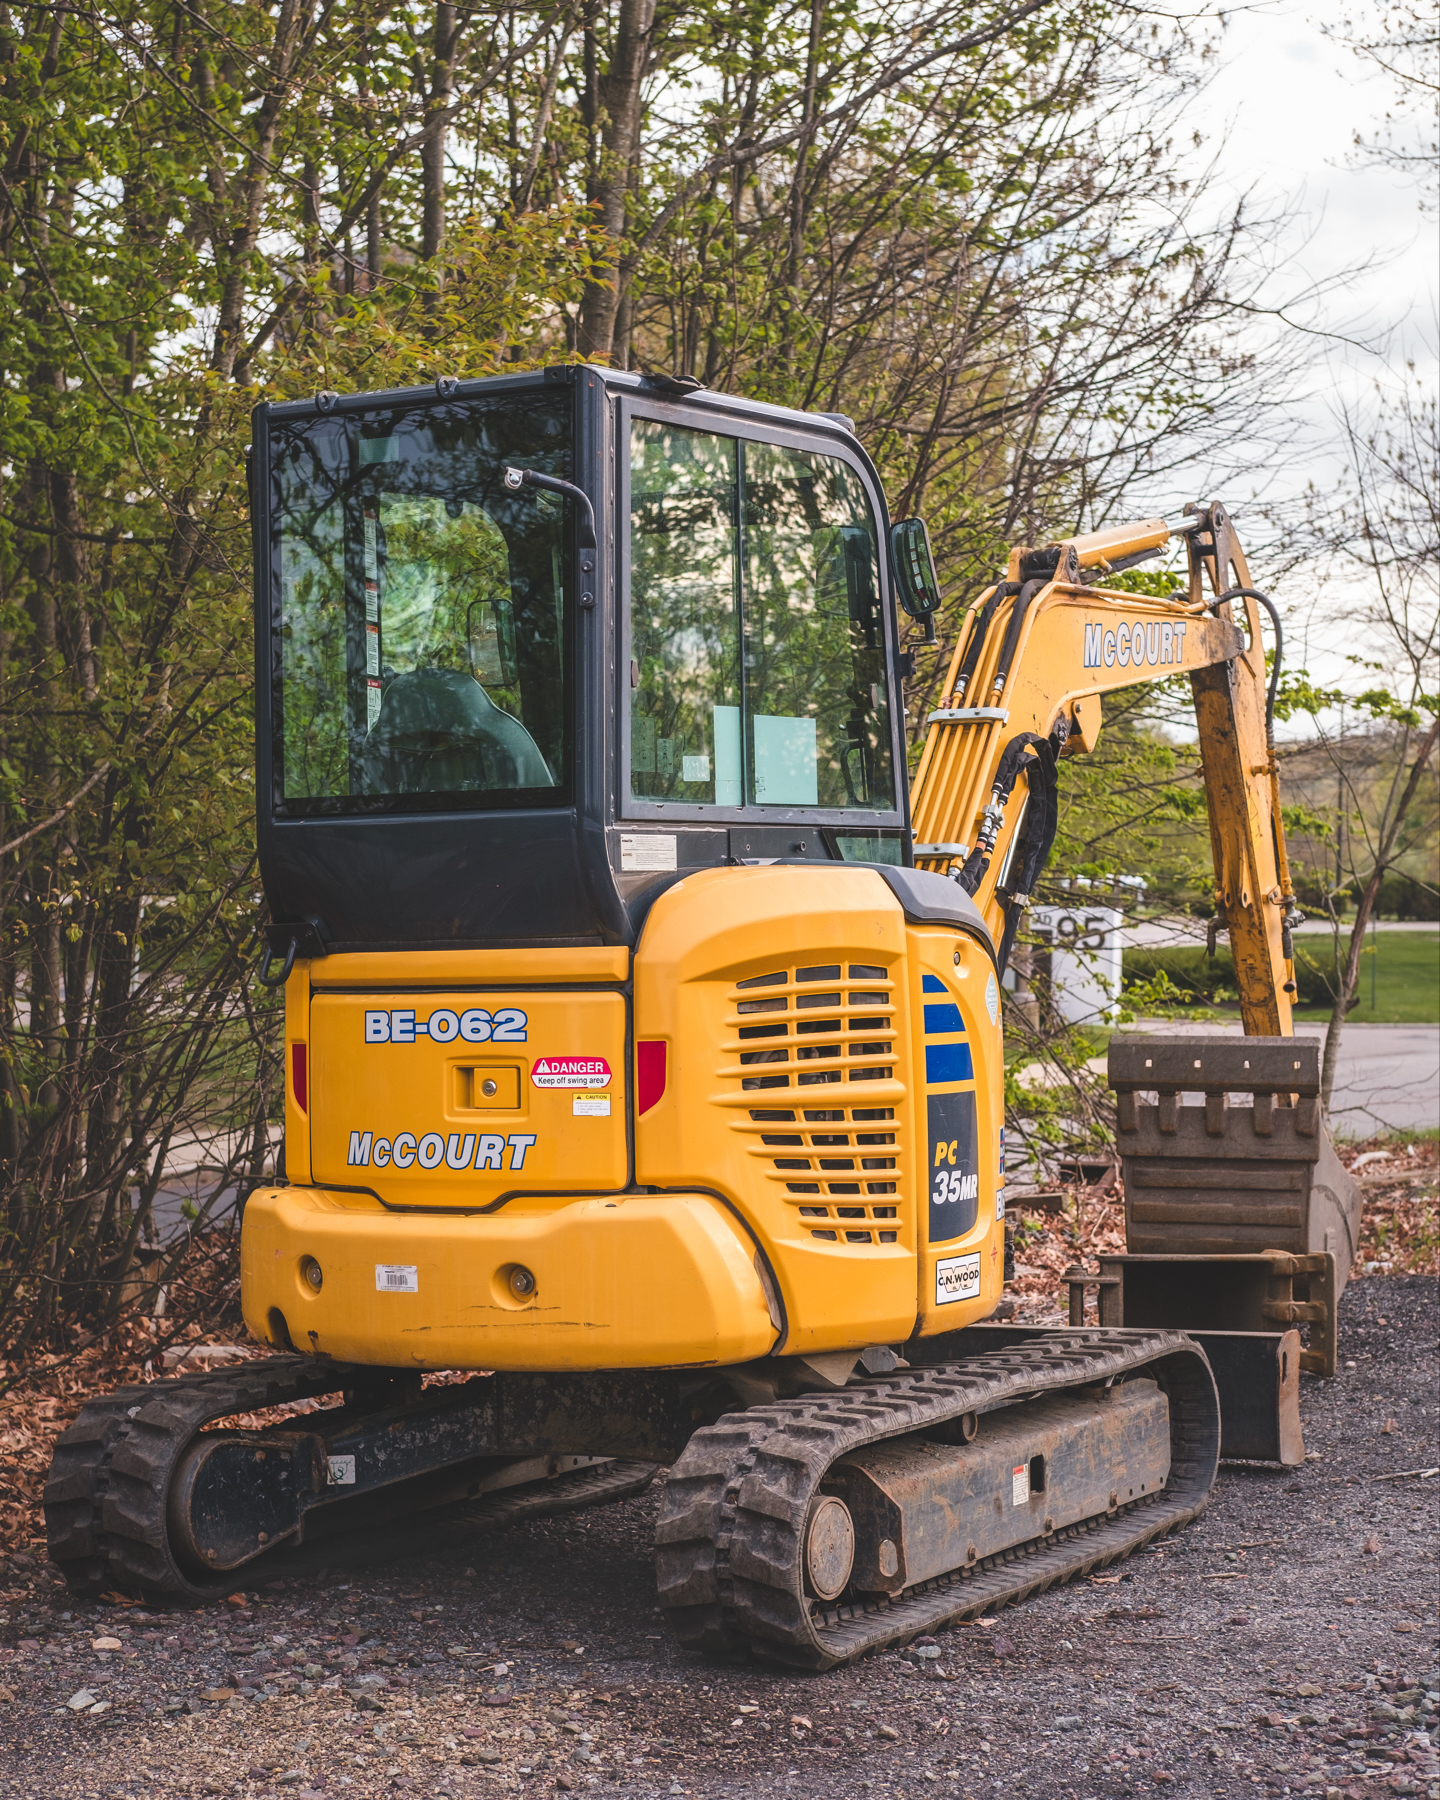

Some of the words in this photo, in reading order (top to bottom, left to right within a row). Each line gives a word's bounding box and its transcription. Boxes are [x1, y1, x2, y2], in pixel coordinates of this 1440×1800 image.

[1084, 622, 1187, 668] McCOURT
[1057, 916, 1105, 949] 95
[365, 1008, 527, 1043] BE-062
[538, 1077, 555, 1085] Keep
[567, 1077, 587, 1085] swing
[551, 1062, 604, 1073] DANGER
[347, 1131, 537, 1170] McCOURT
[934, 1140, 958, 1166] PC
[933, 1170, 977, 1205] 35MR
